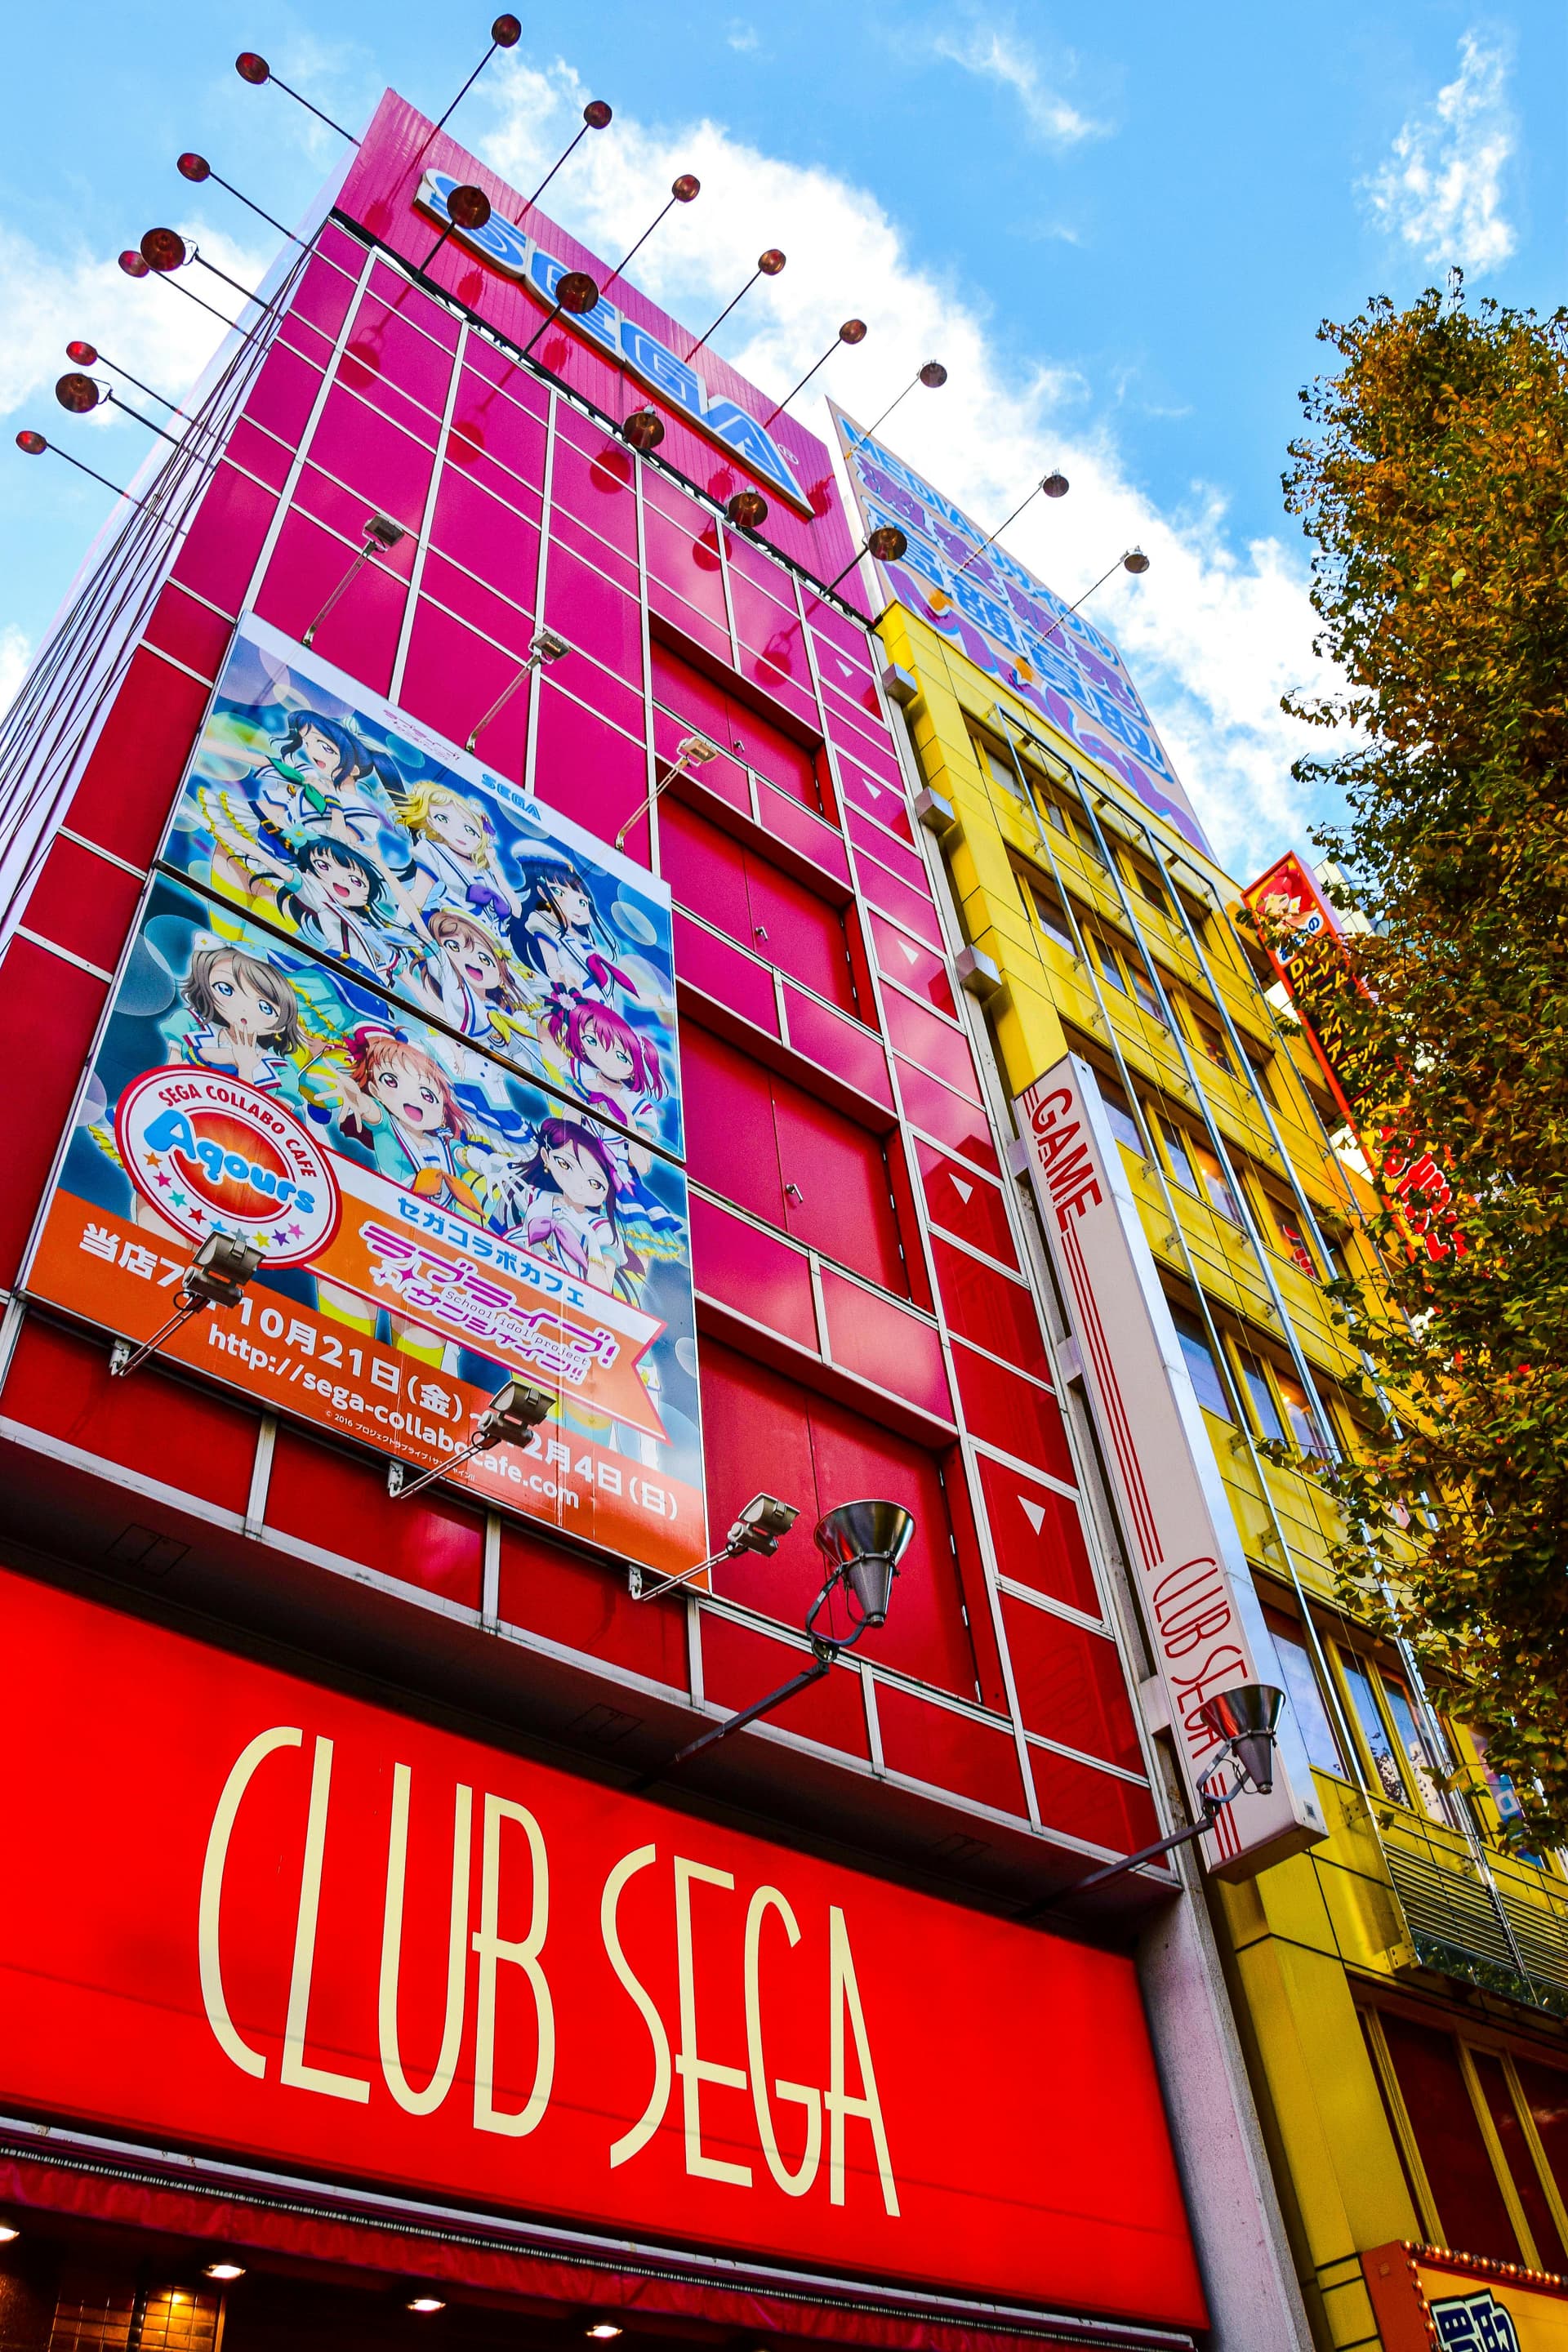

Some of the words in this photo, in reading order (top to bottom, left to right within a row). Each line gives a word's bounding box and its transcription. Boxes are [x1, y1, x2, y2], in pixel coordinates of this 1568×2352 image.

[415, 167, 814, 518] SEGA
[481, 773, 541, 822] SEGA
[144, 1109, 315, 1214] Aqours
[158, 1084, 202, 1107] SEGA
[206, 1085, 285, 1134] COLLABO
[286, 1138, 317, 1178] CAFE
[1031, 1088, 1102, 1233] GAME
[398, 1197, 585, 1308] セガコラボカフェ
[445, 1290, 492, 1318] School
[500, 1318, 529, 1338] idol
[535, 1334, 588, 1366] project
[335, 1414, 353, 1428] 2016
[1152, 1557, 1232, 1659] CLUB
[198, 1726, 555, 2137] CLUB
[601, 1843, 901, 2217] SEGA
